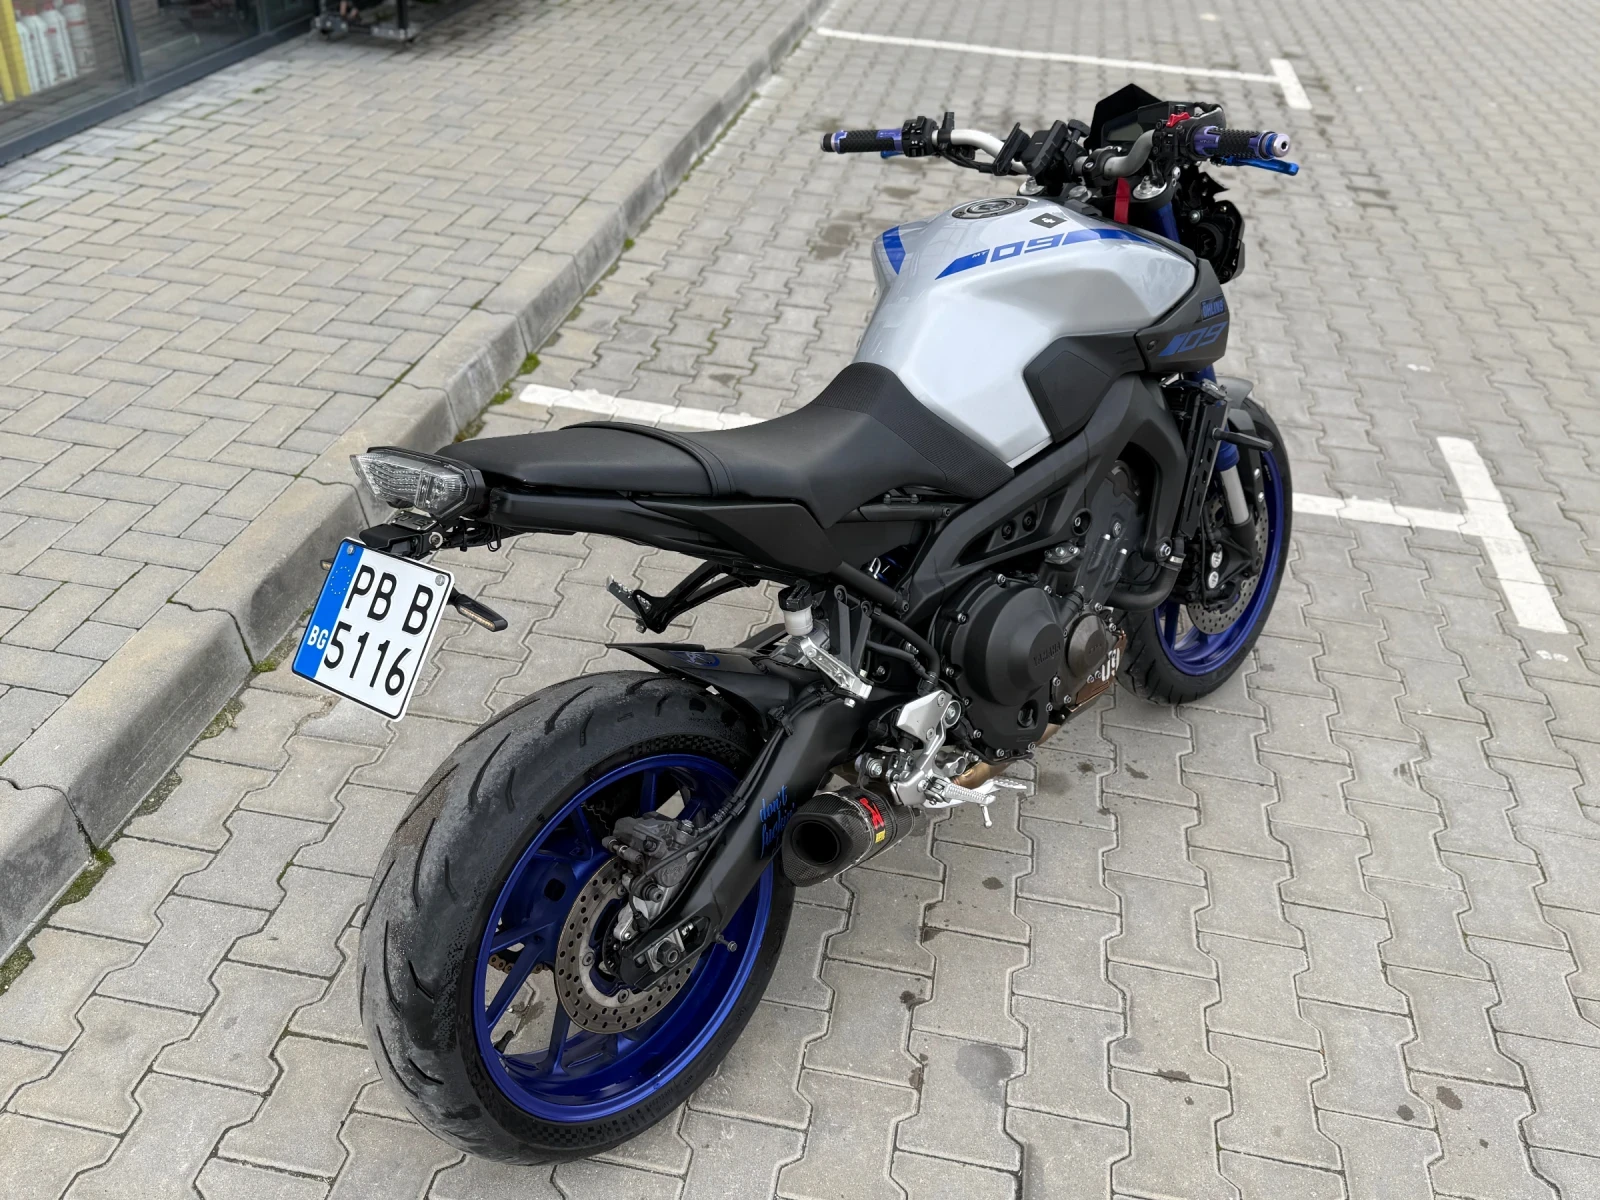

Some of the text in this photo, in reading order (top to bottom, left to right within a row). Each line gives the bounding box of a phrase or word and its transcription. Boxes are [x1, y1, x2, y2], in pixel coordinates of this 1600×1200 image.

[990, 233, 1067, 263] 09
[1178, 321, 1228, 353] 09
[345, 564, 434, 635] PB B
[307, 625, 329, 650] BG
[323, 621, 412, 696] 5116
